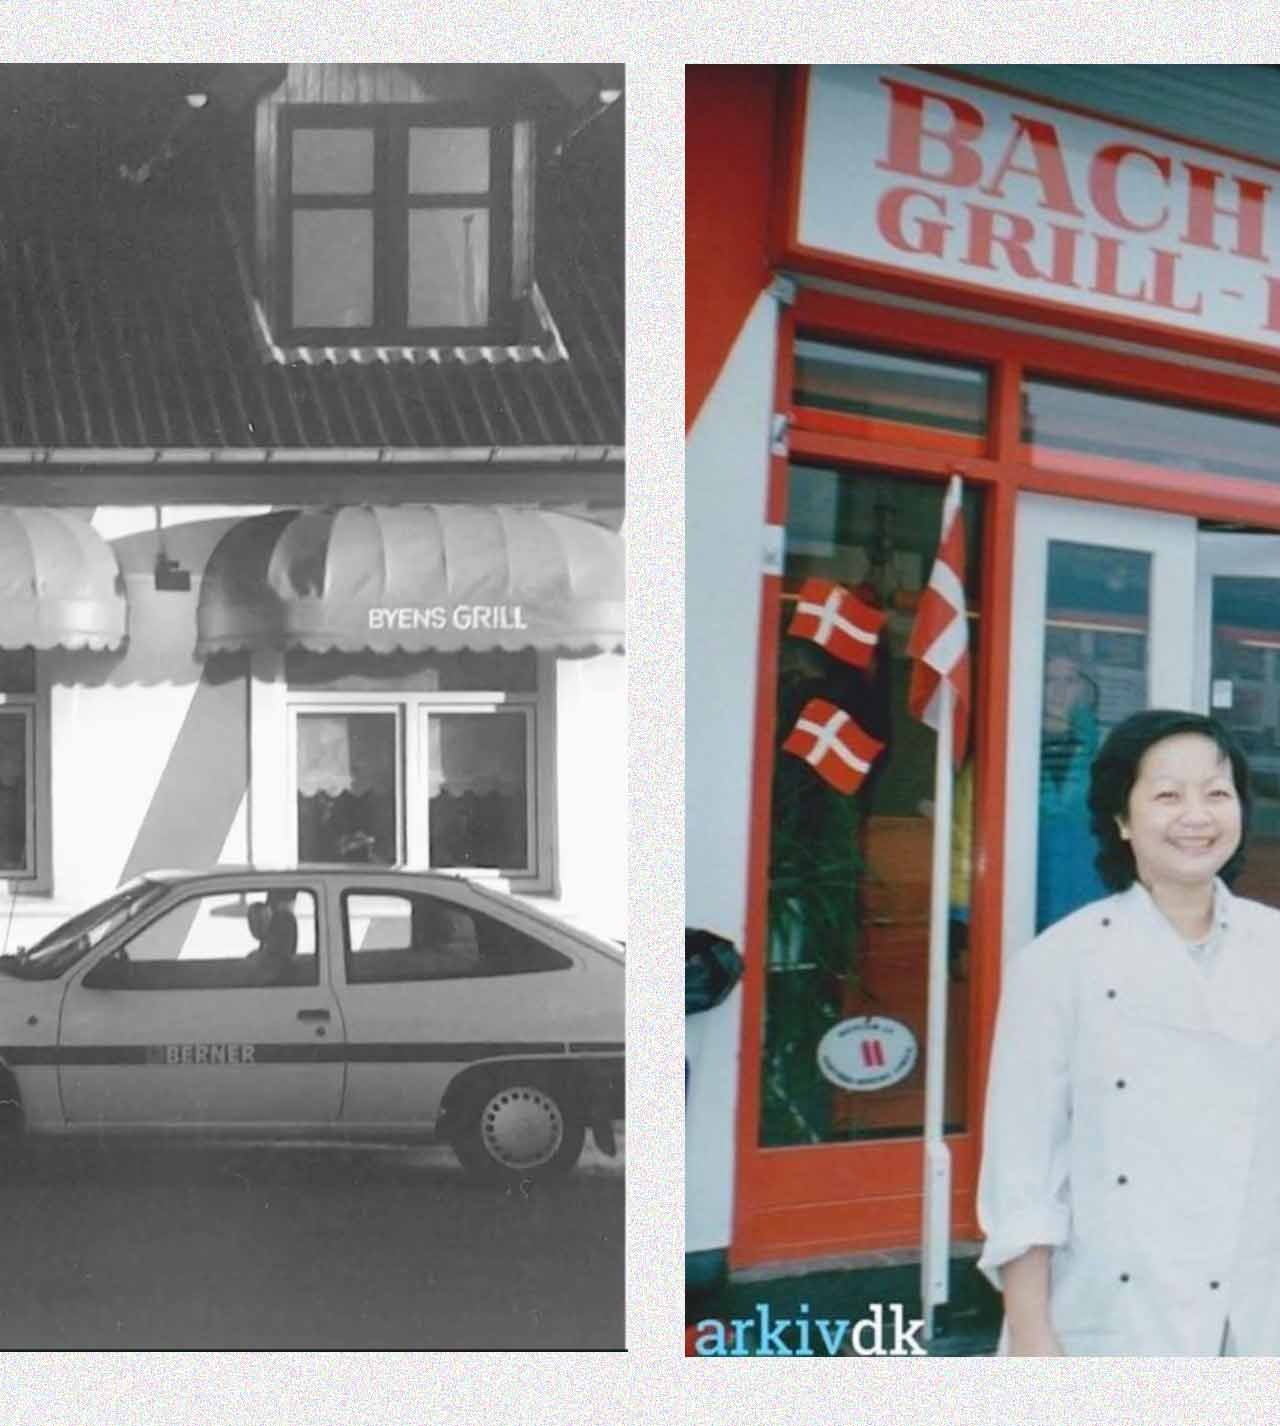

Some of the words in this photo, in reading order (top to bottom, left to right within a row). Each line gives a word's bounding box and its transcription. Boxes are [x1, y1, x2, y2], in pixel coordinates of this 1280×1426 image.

[369, 605, 447, 630] BYENS
[453, 604, 528, 631] GRILL
[166, 1043, 256, 1064] BERNER
